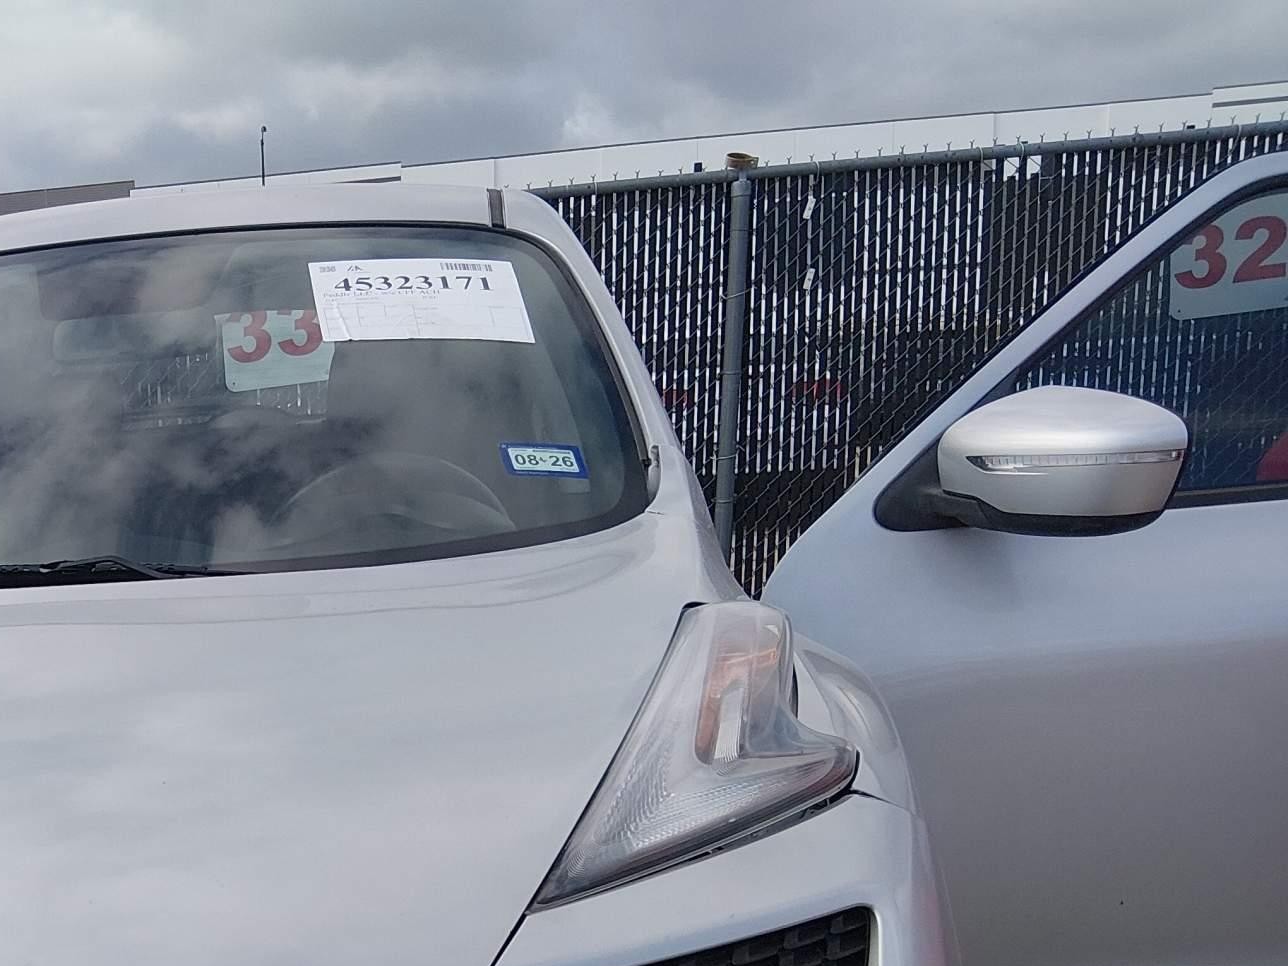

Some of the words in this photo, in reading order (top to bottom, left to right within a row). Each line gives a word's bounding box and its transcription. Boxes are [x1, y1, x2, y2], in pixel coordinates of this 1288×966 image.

[1173, 215, 1288, 290] 32
[334, 274, 494, 292] 45323171
[226, 309, 323, 364] 33
